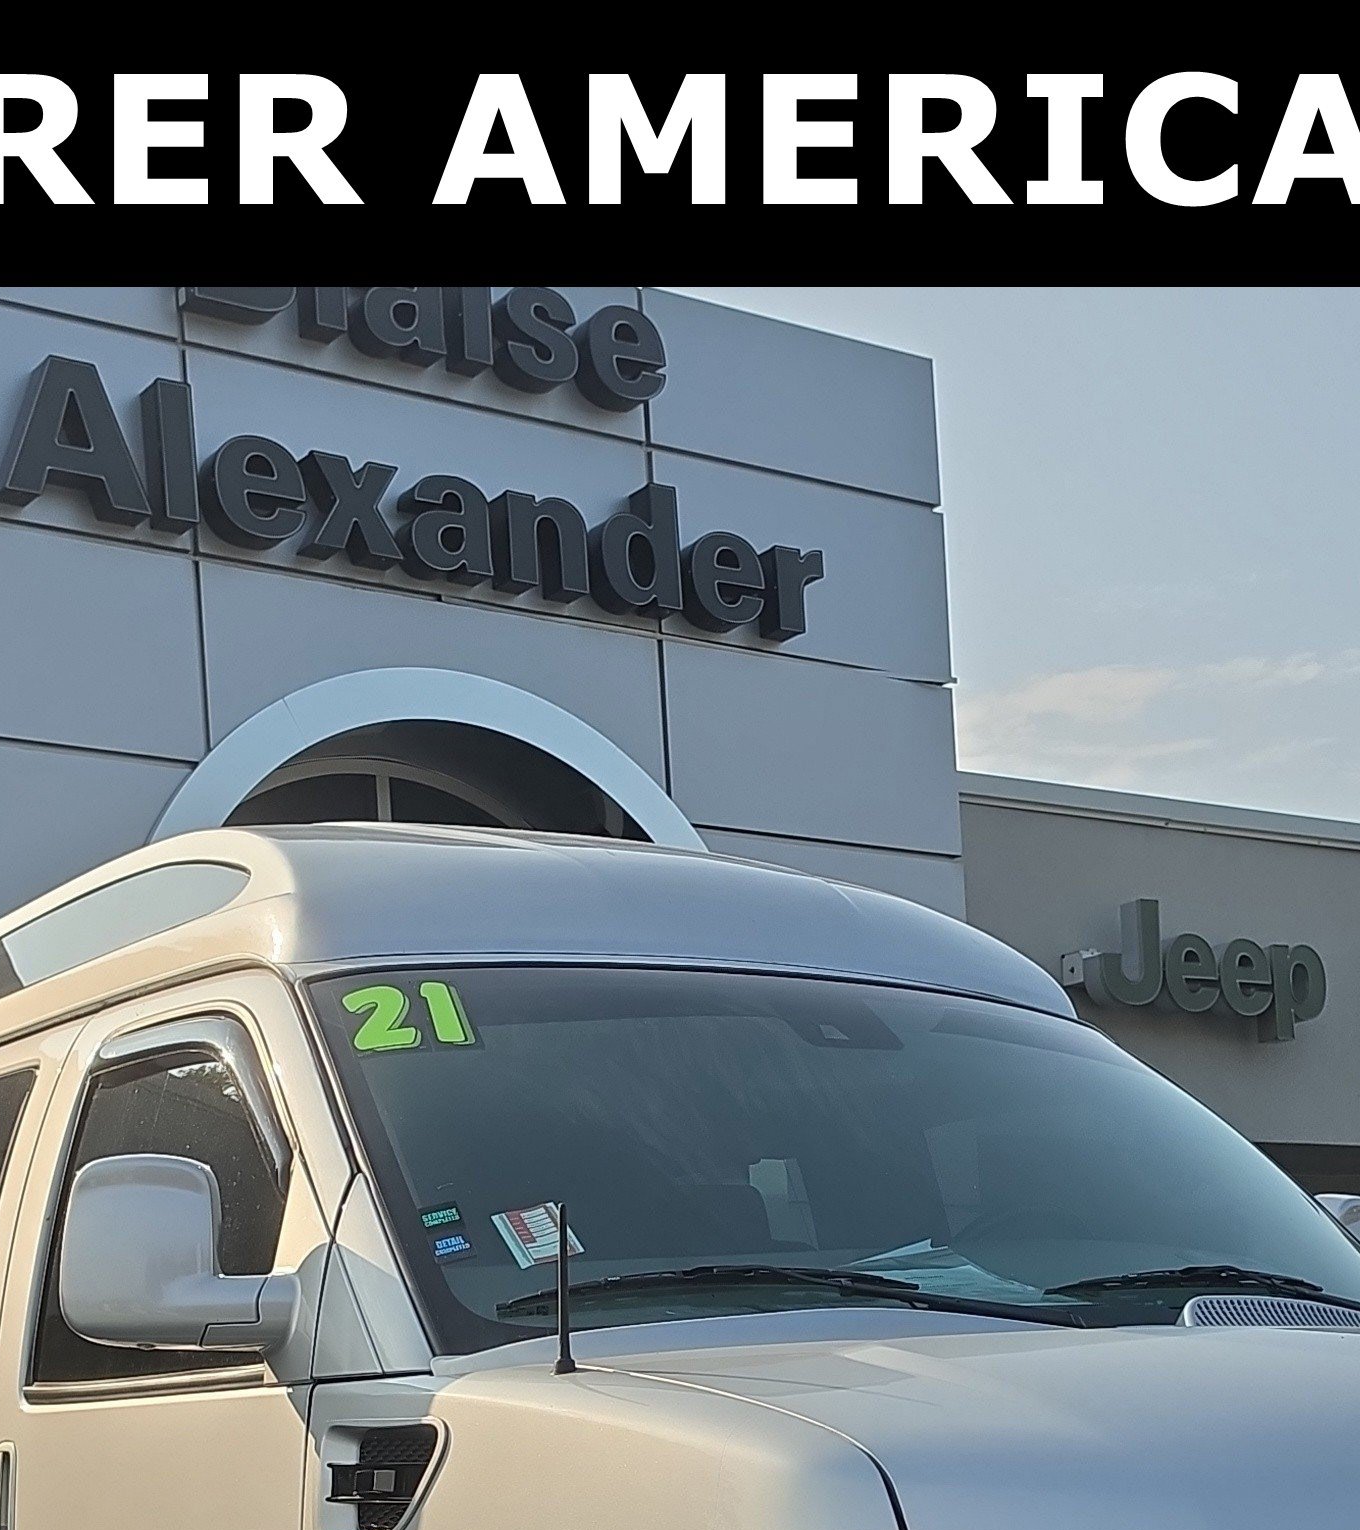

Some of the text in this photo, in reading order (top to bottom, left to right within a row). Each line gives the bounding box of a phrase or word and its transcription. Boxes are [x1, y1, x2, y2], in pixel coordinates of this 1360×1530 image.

[1083, 897, 1328, 1043] Jeep
[342, 980, 476, 1051] 21
[435, 1235, 465, 1249] DETAIL
